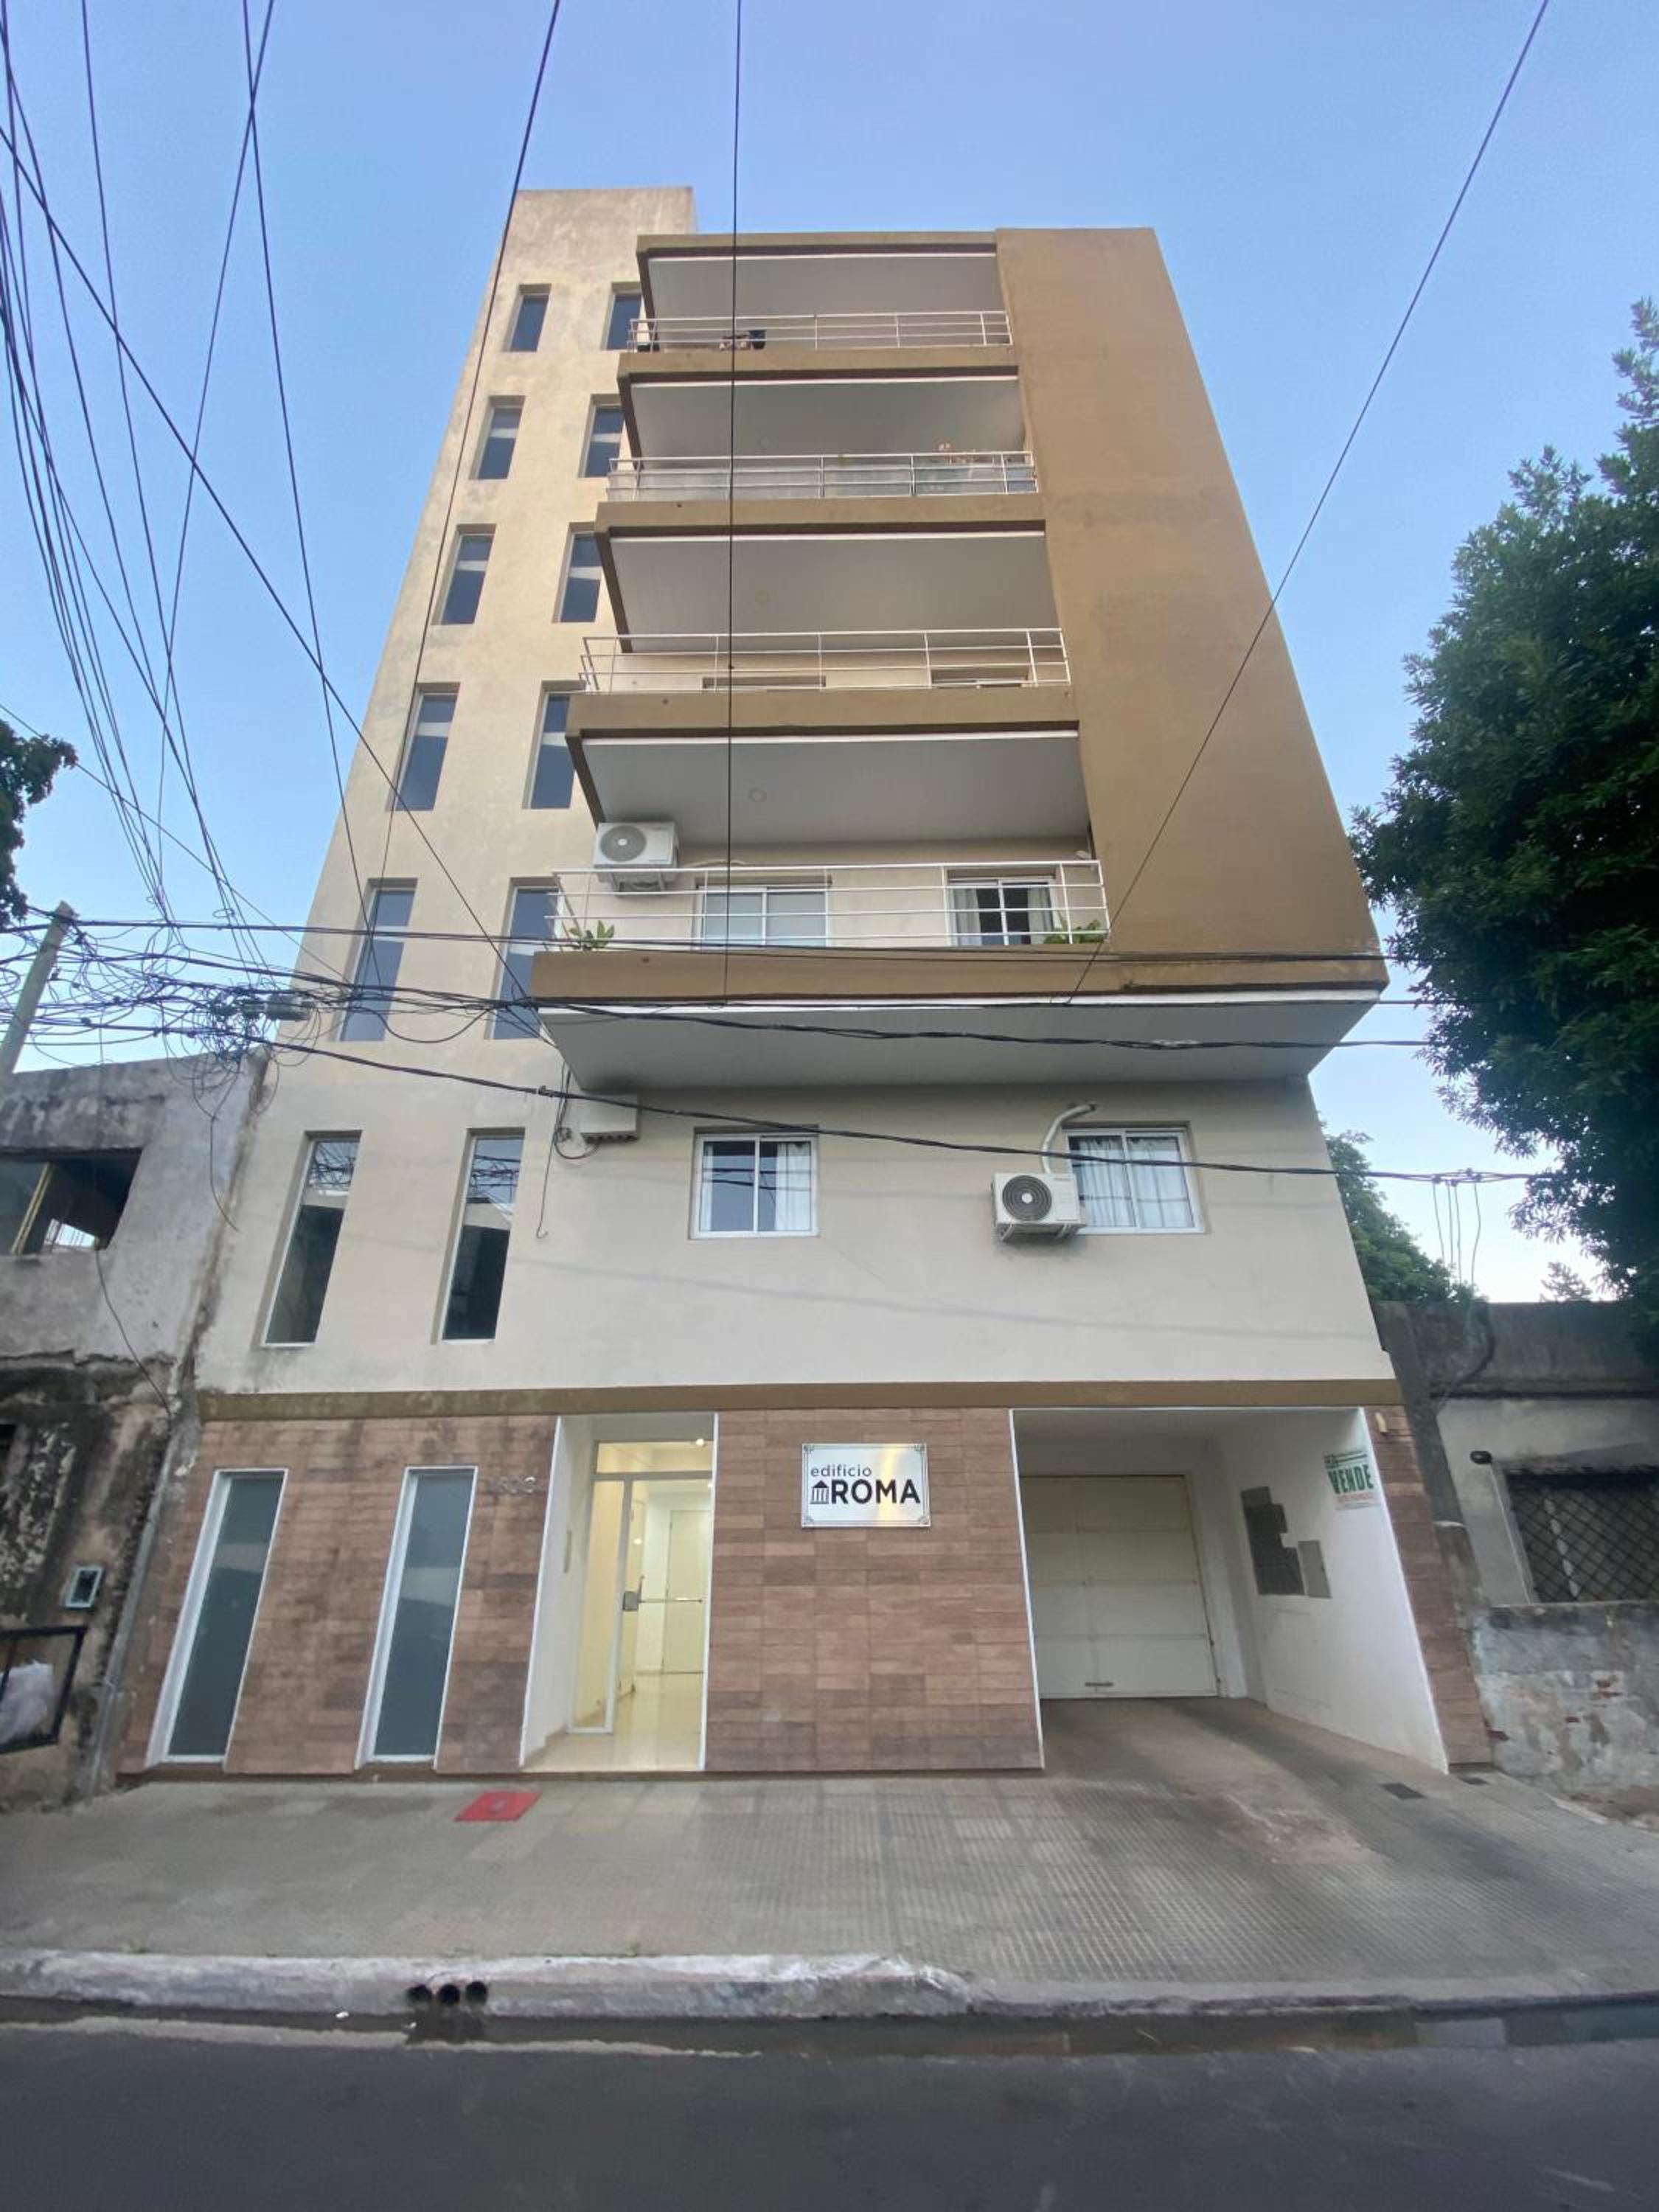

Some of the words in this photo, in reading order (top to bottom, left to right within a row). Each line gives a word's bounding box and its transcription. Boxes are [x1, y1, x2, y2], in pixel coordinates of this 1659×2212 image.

[810, 1464, 872, 1477] edificio
[1327, 1464, 1374, 1494] VENDE
[831, 1478, 921, 1504] ROMA
